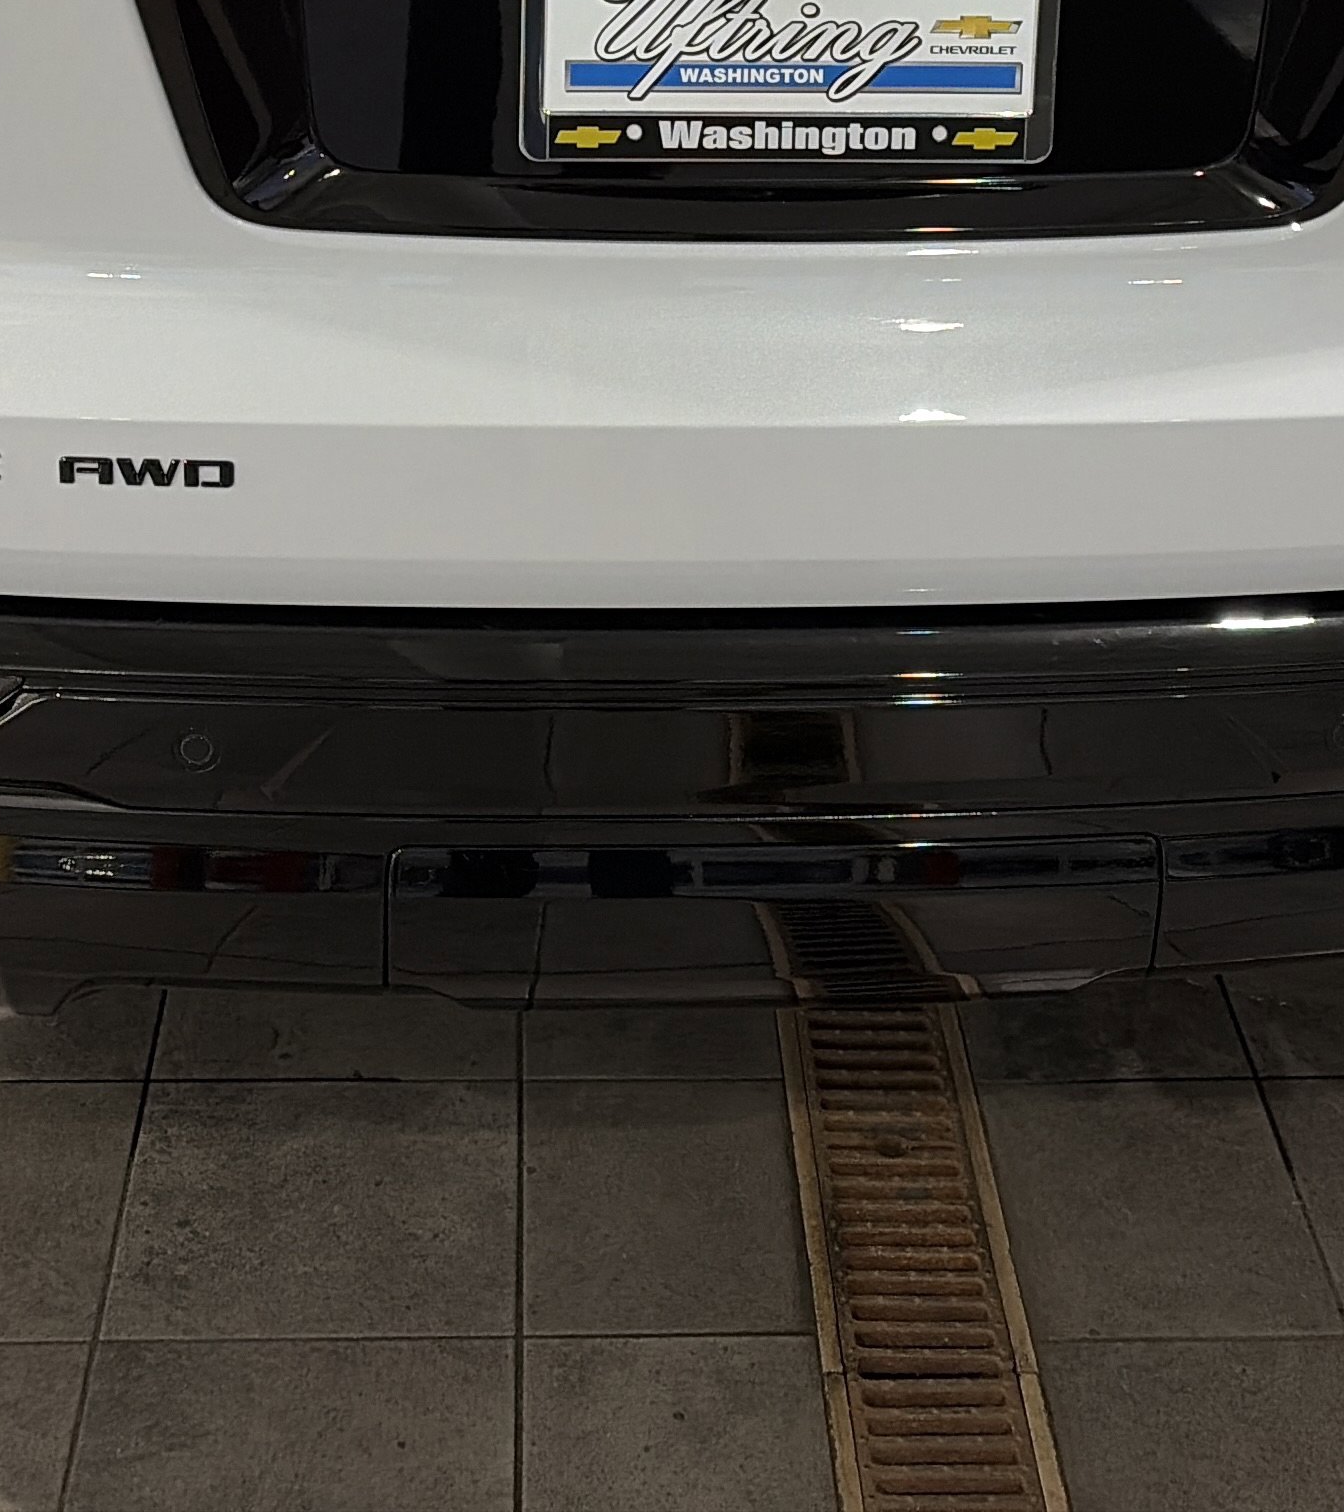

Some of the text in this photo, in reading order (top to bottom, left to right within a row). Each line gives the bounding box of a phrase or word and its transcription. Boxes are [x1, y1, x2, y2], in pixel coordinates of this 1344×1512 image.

[929, 44, 1017, 56] CHEVROLET
[679, 67, 824, 85] WASHINGTON
[658, 119, 917, 155] Washington
[58, 455, 237, 489] AWD
